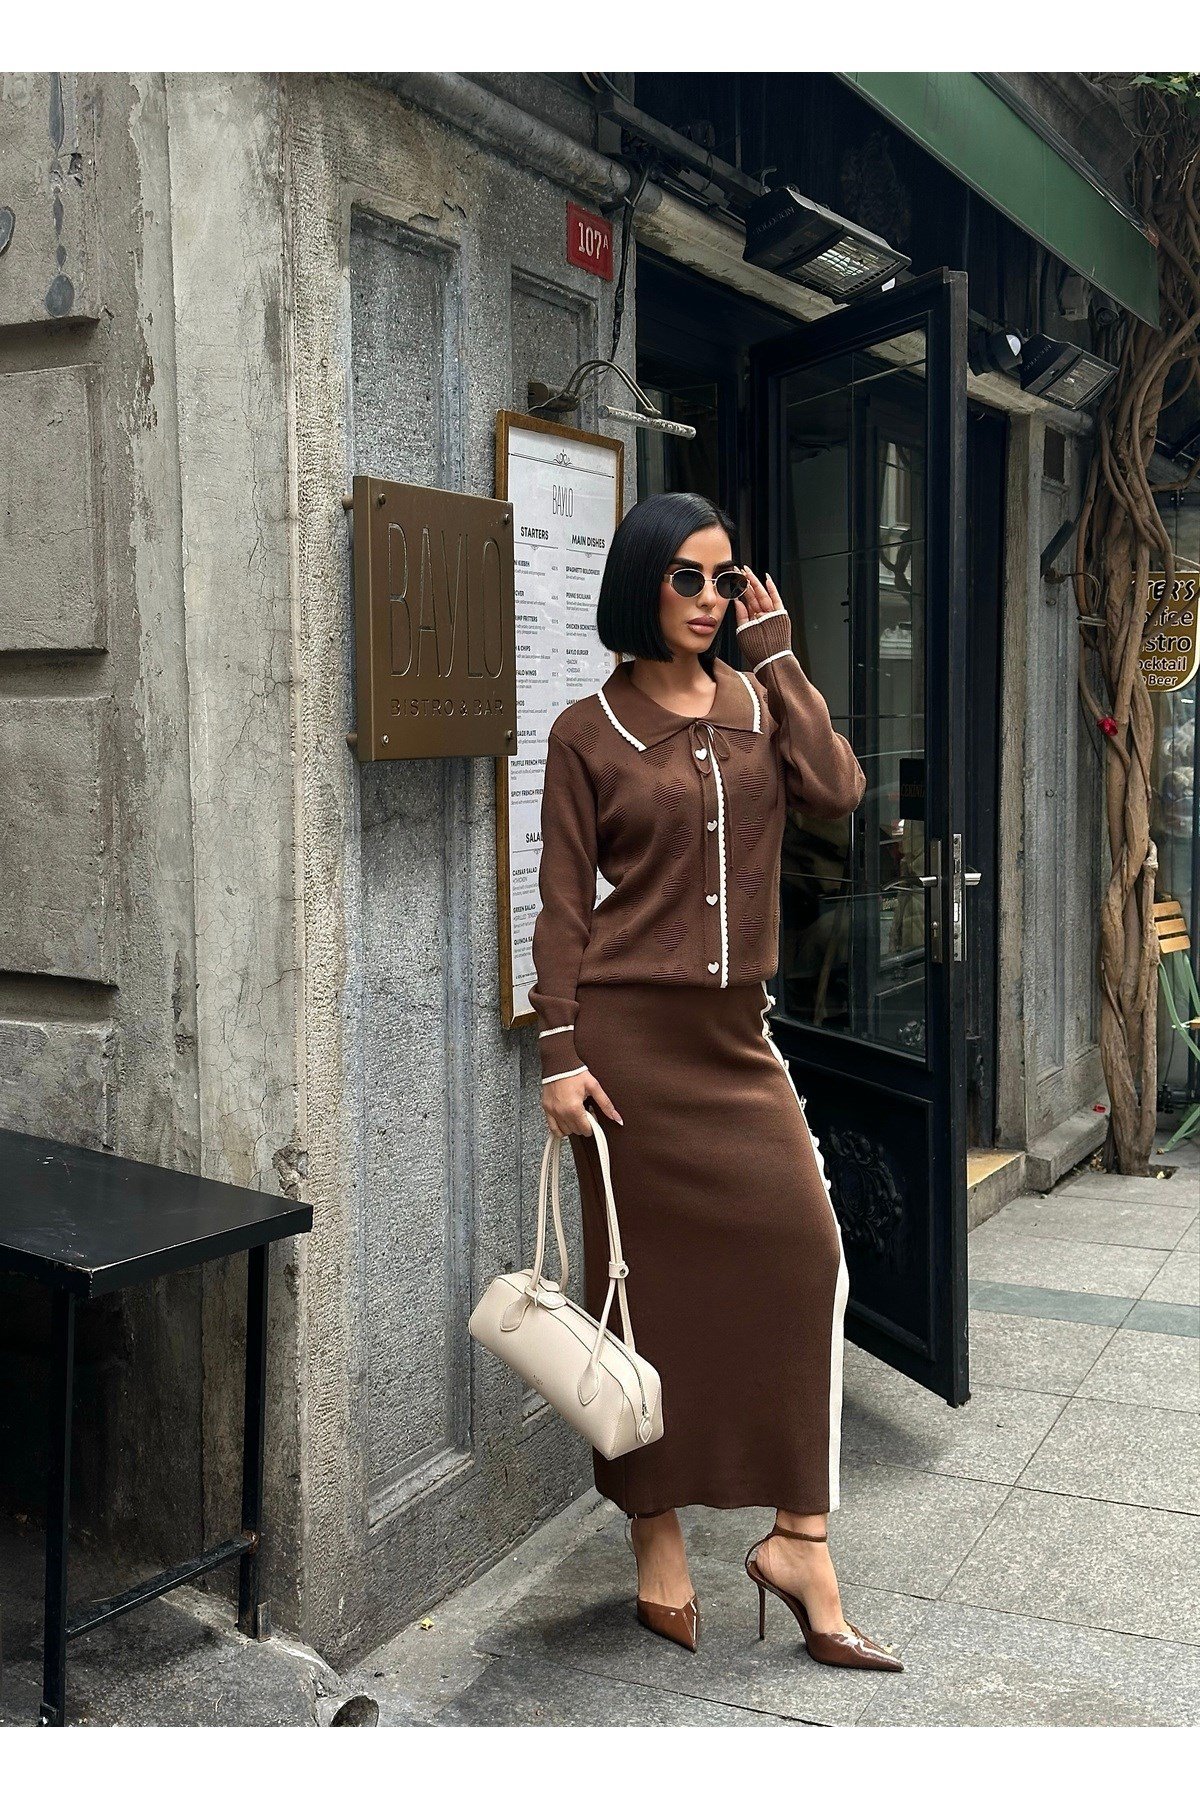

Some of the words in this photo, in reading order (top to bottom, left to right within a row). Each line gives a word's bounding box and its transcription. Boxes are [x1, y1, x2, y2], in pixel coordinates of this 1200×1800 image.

[552, 484, 574, 518] BAYLO
[520, 526, 549, 540] STARTERS
[571, 534, 586, 546] MAIN
[587, 537, 605, 548] DISHES
[387, 521, 504, 679] BAYLO
[1149, 674, 1178, 686] Beer
[390, 698, 455, 717] BISTRO
[459, 699, 469, 717] &
[473, 699, 504, 717] BAR
